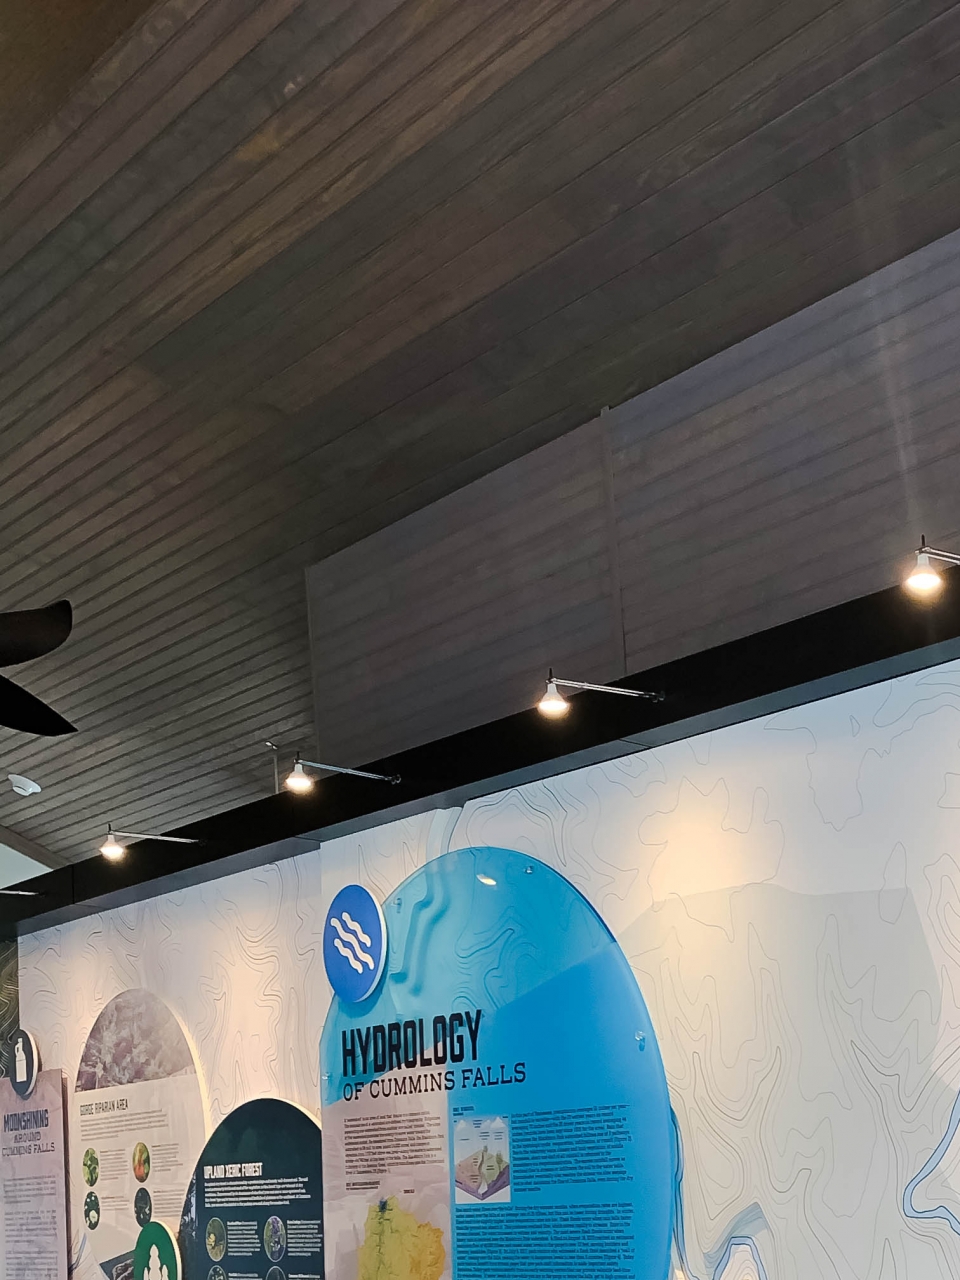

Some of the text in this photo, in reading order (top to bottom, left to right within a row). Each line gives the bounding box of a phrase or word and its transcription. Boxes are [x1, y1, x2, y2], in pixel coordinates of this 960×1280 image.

[341, 1009, 482, 1077] HYDROLOGY
[342, 1062, 527, 1101] OF CUMMINS FALLS
[116, 1098, 129, 1111] AREA
[3, 1109, 49, 1132] MOONSHINING
[13, 1131, 42, 1143] AROUND
[2, 1142, 55, 1157] CUMMINS FALLS
[203, 1165, 224, 1179] UPLAND
[242, 1162, 263, 1177] FOREST
